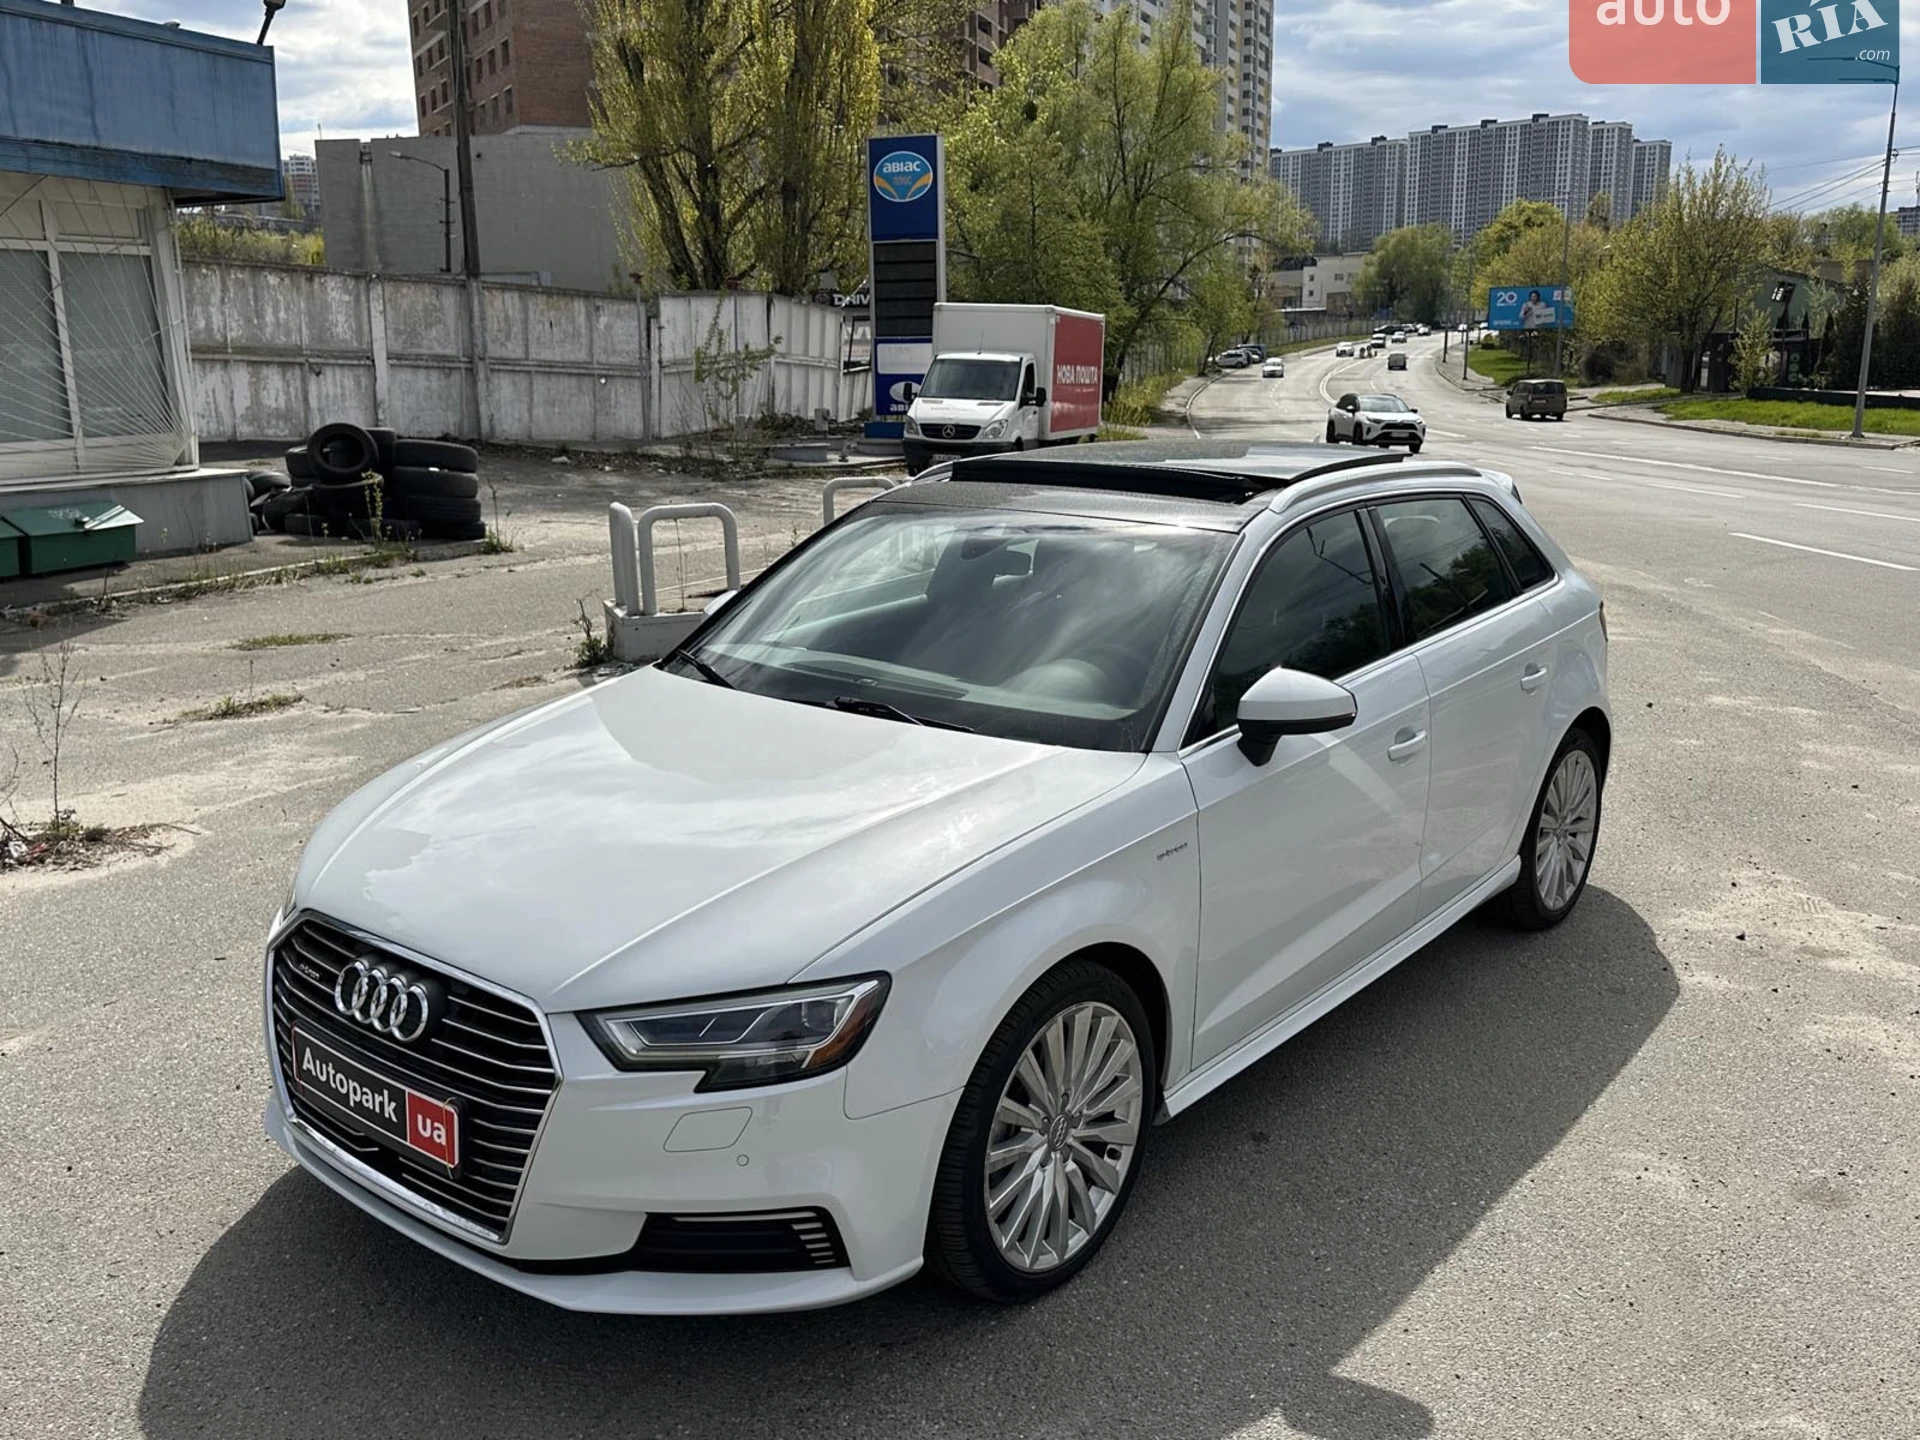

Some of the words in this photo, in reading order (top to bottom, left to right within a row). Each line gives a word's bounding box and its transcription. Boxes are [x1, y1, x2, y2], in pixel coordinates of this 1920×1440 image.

[1056, 364, 1075, 385] НОВА
[1075, 365, 1099, 385] ПОШТА
[302, 1046, 398, 1123] Autopark
[417, 1113, 447, 1146] ua
